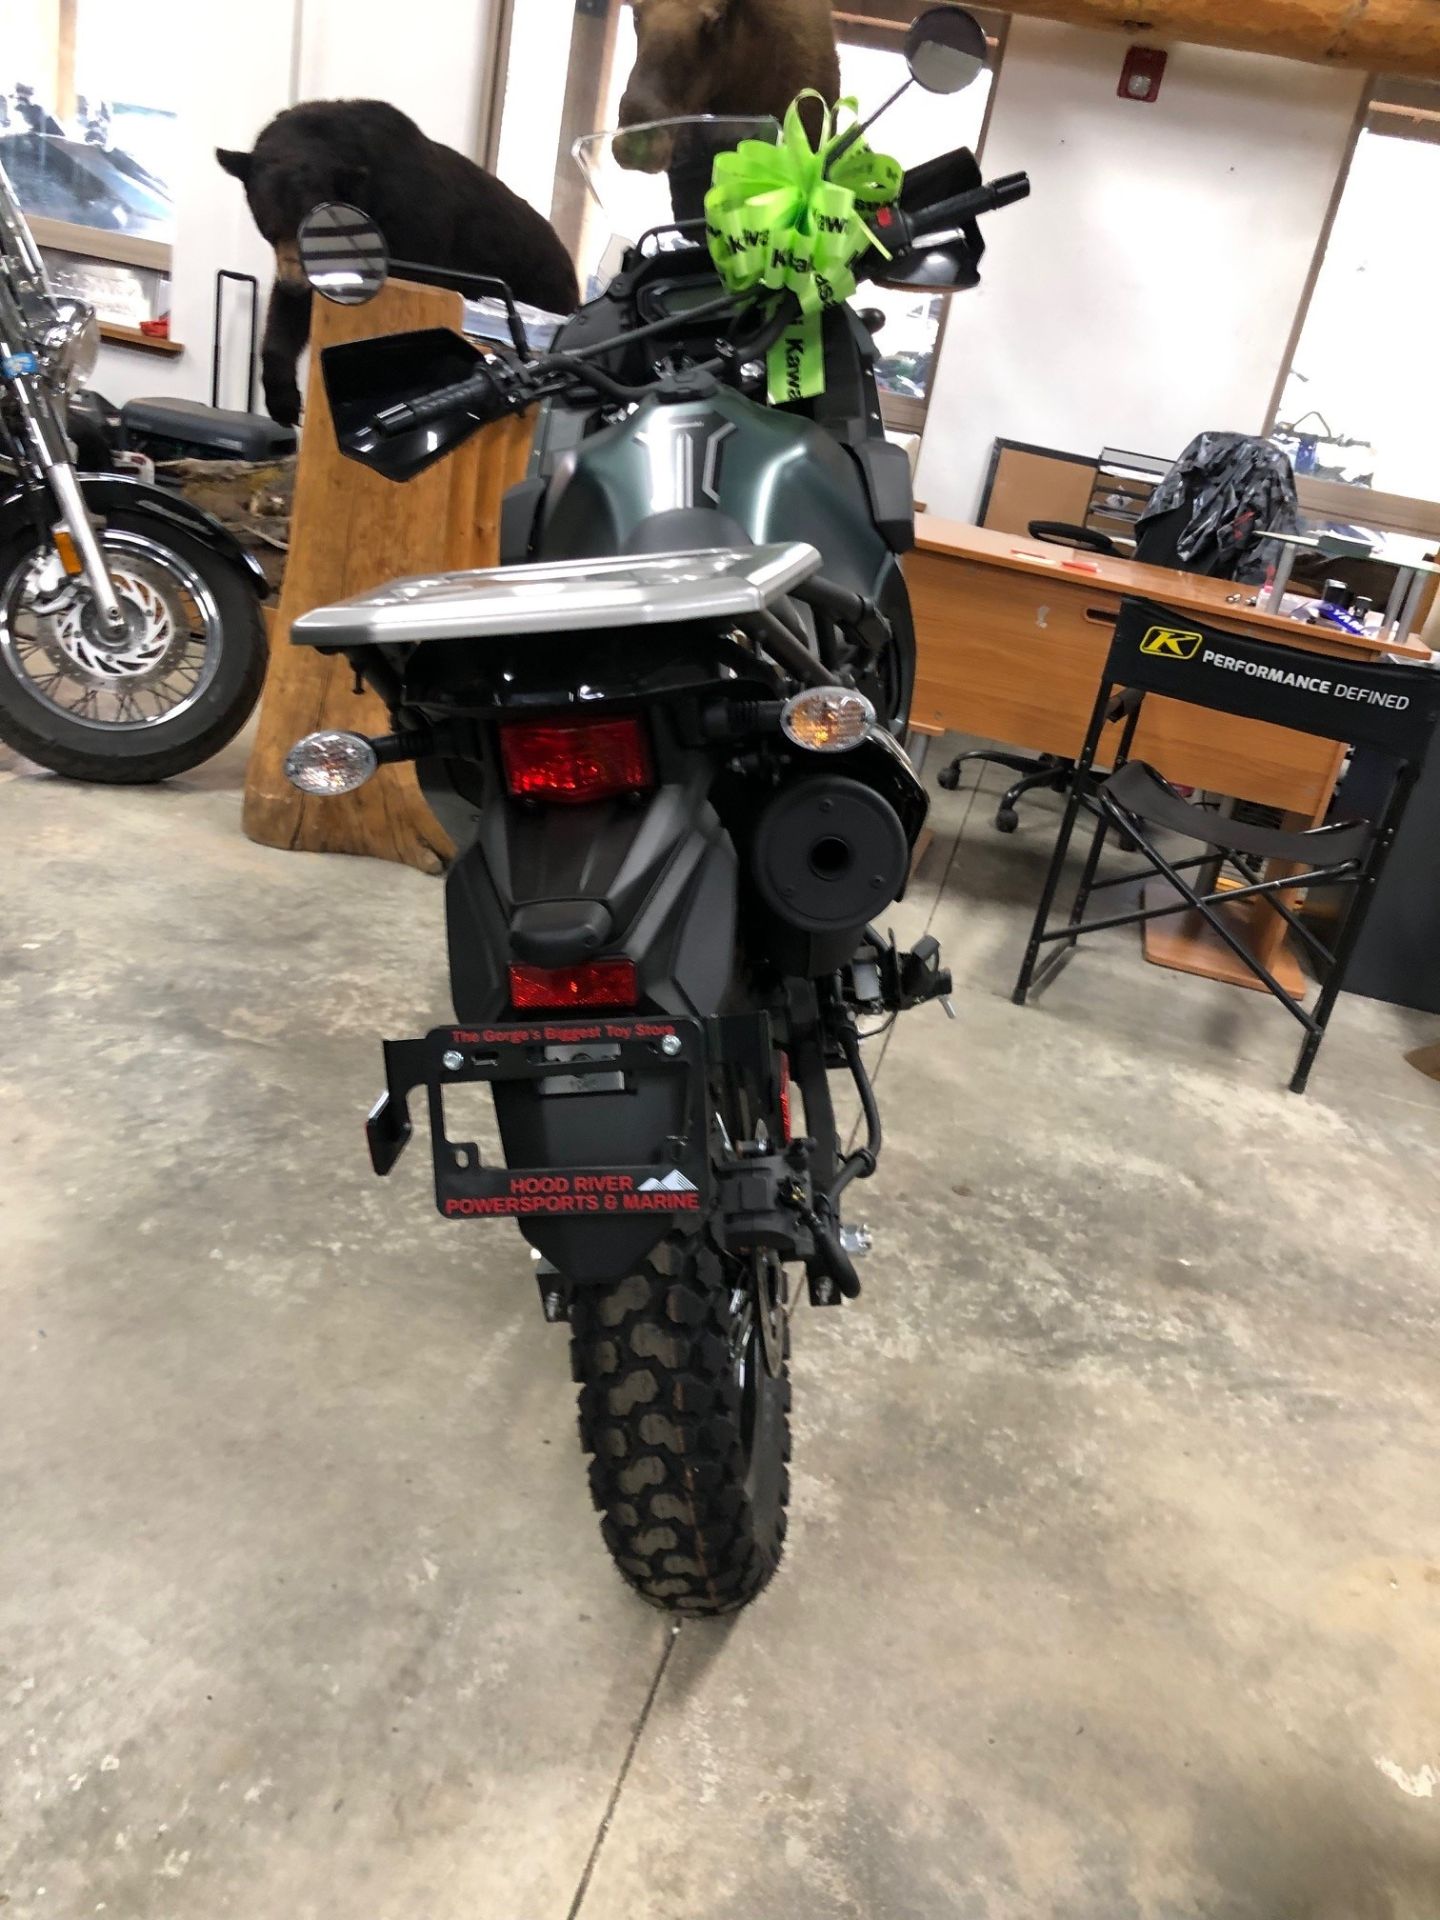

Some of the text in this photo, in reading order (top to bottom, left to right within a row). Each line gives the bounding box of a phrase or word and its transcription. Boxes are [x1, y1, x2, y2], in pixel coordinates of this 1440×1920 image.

[1202, 649, 1410, 711] PERFORMANCE DEFINED
[452, 1022, 676, 1045] The Gorge's Biggest Toy Store
[510, 1175, 634, 1194] HOOD RIVER
[444, 1193, 700, 1215] POWERSPORTS & MARINE
